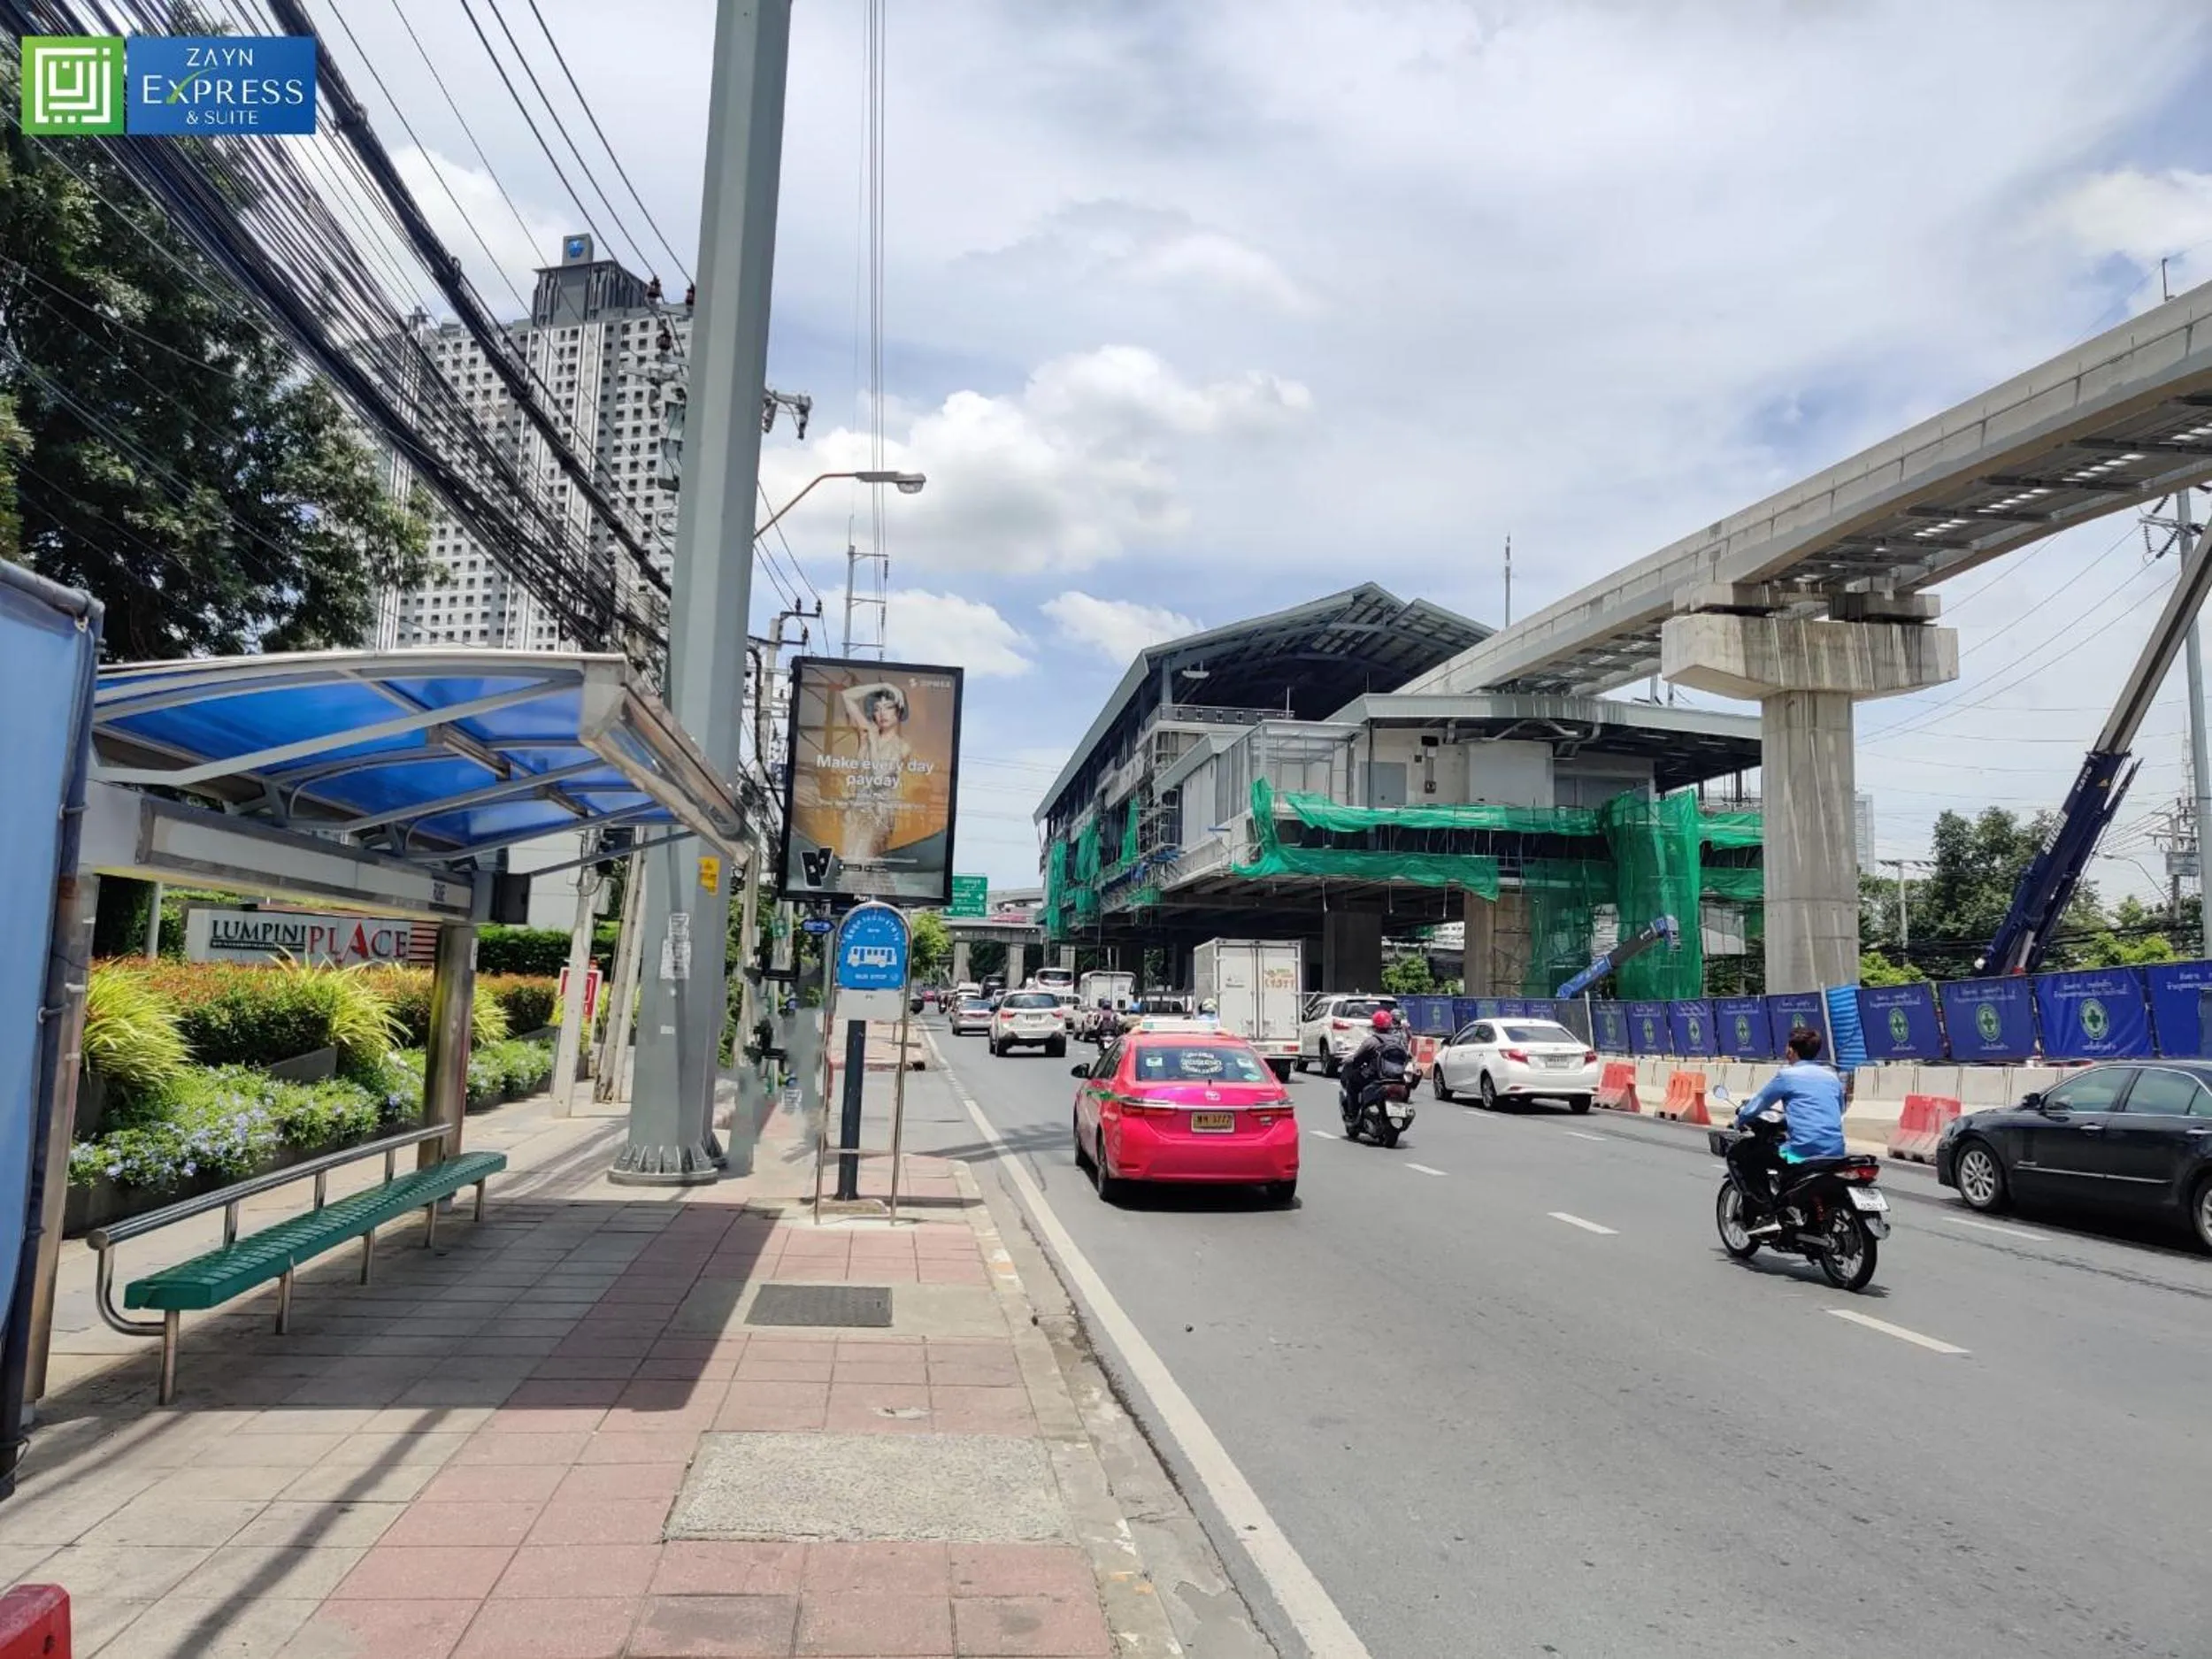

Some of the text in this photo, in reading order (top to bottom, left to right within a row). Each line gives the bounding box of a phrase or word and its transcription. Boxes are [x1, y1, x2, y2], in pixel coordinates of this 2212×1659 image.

[817, 754, 859, 769] Make
[907, 757, 934, 775] day
[212, 919, 407, 964] LUMPINI PLACE
